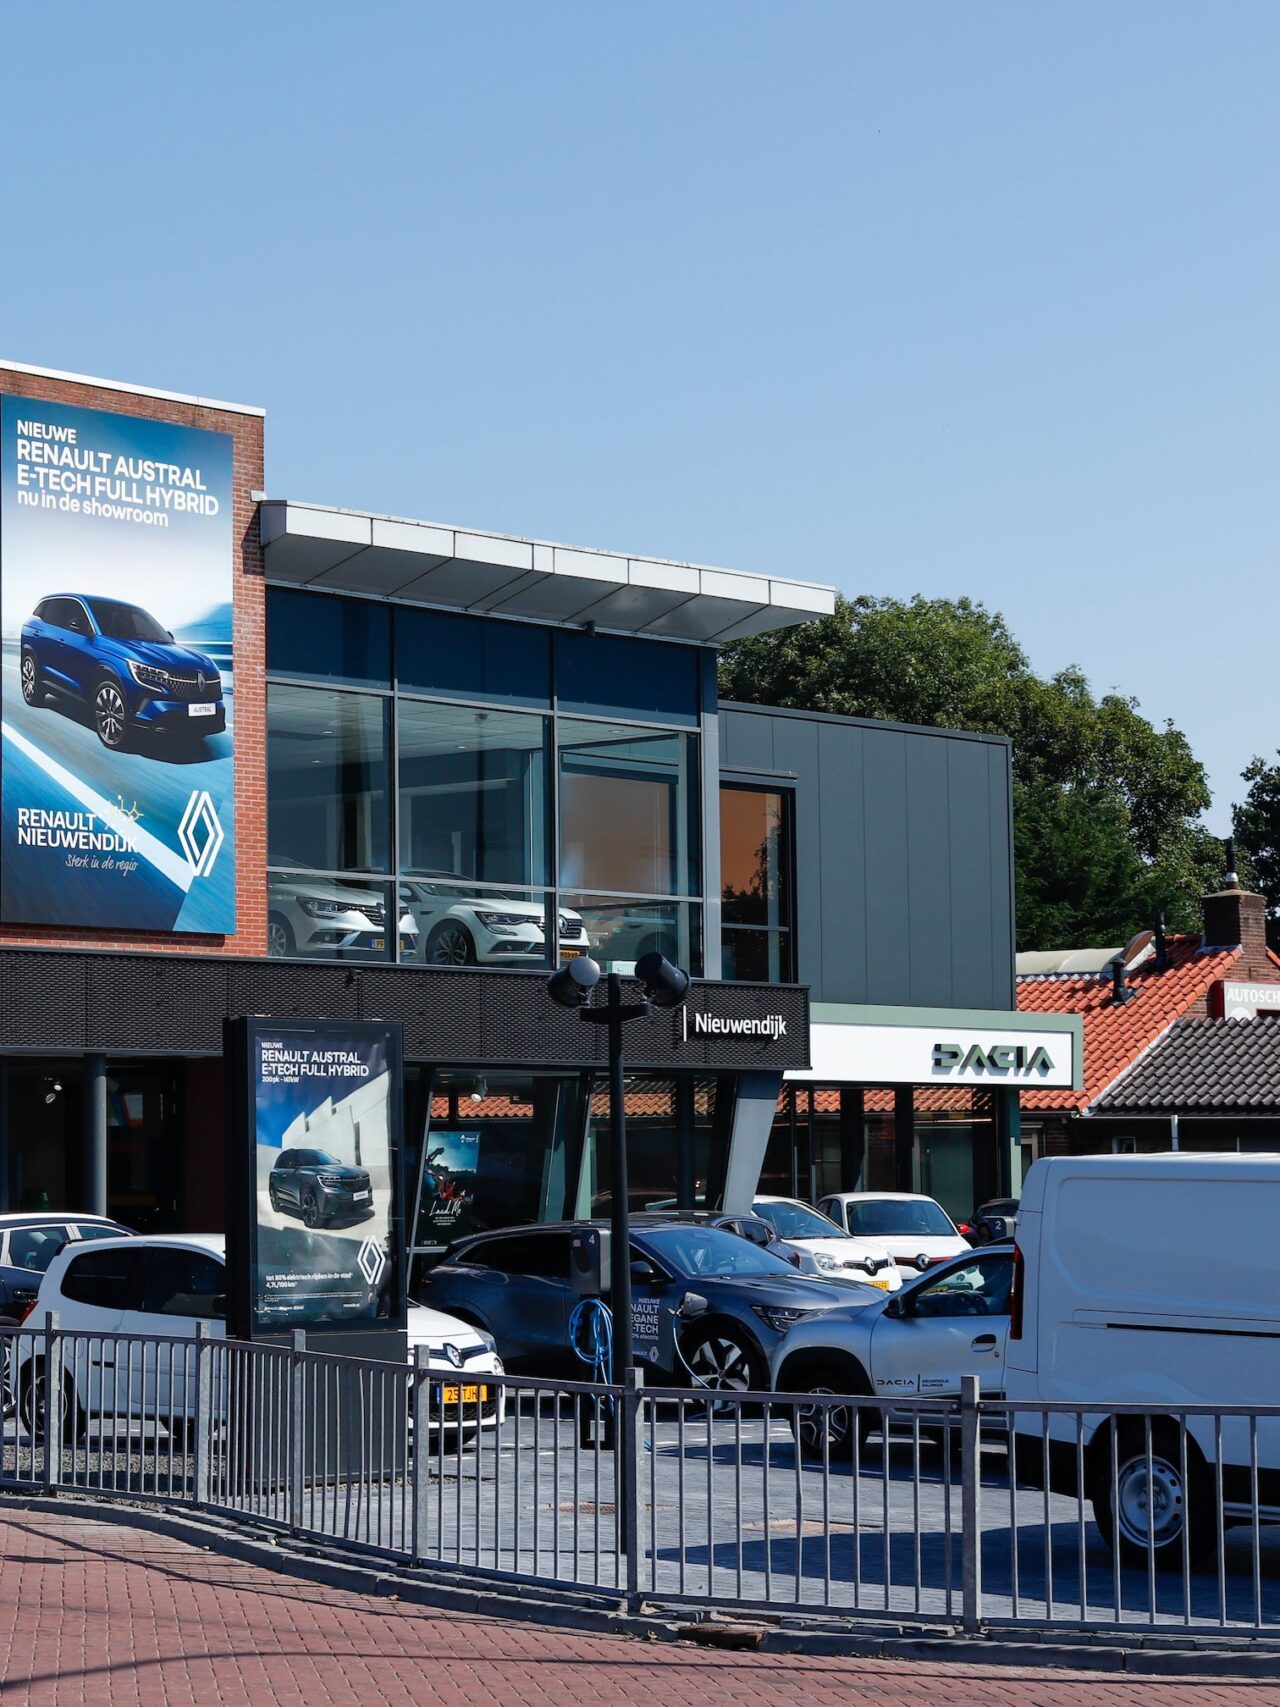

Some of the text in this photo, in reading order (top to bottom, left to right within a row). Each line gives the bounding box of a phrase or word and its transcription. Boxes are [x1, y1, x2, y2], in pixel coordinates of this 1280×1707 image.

[17, 419, 77, 444] NIEUWE
[17, 438, 207, 491] RENAULT AUSTRAL
[17, 463, 220, 516] E-TECH FULL HYBRID
[17, 489, 169, 528] nu in de showroom
[17, 807, 97, 831] RENAULT
[17, 826, 140, 853] NIEUWENDIJK
[65, 854, 139, 877] Sterk in de regio
[694, 1012, 788, 1040] Nieuwendijk
[261, 1049, 362, 1064] RENAULT AUSTRAL
[932, 1043, 1056, 1070] DACIA
[261, 1063, 370, 1077] E-TECH FULL HYBRID
[995, 1220, 1002, 1230] 2
[588, 1234, 596, 1245] 4
[630, 1303, 660, 1314] NAULT
[630, 1313, 659, 1324] EGANE
[632, 1323, 659, 1334] -TECH
